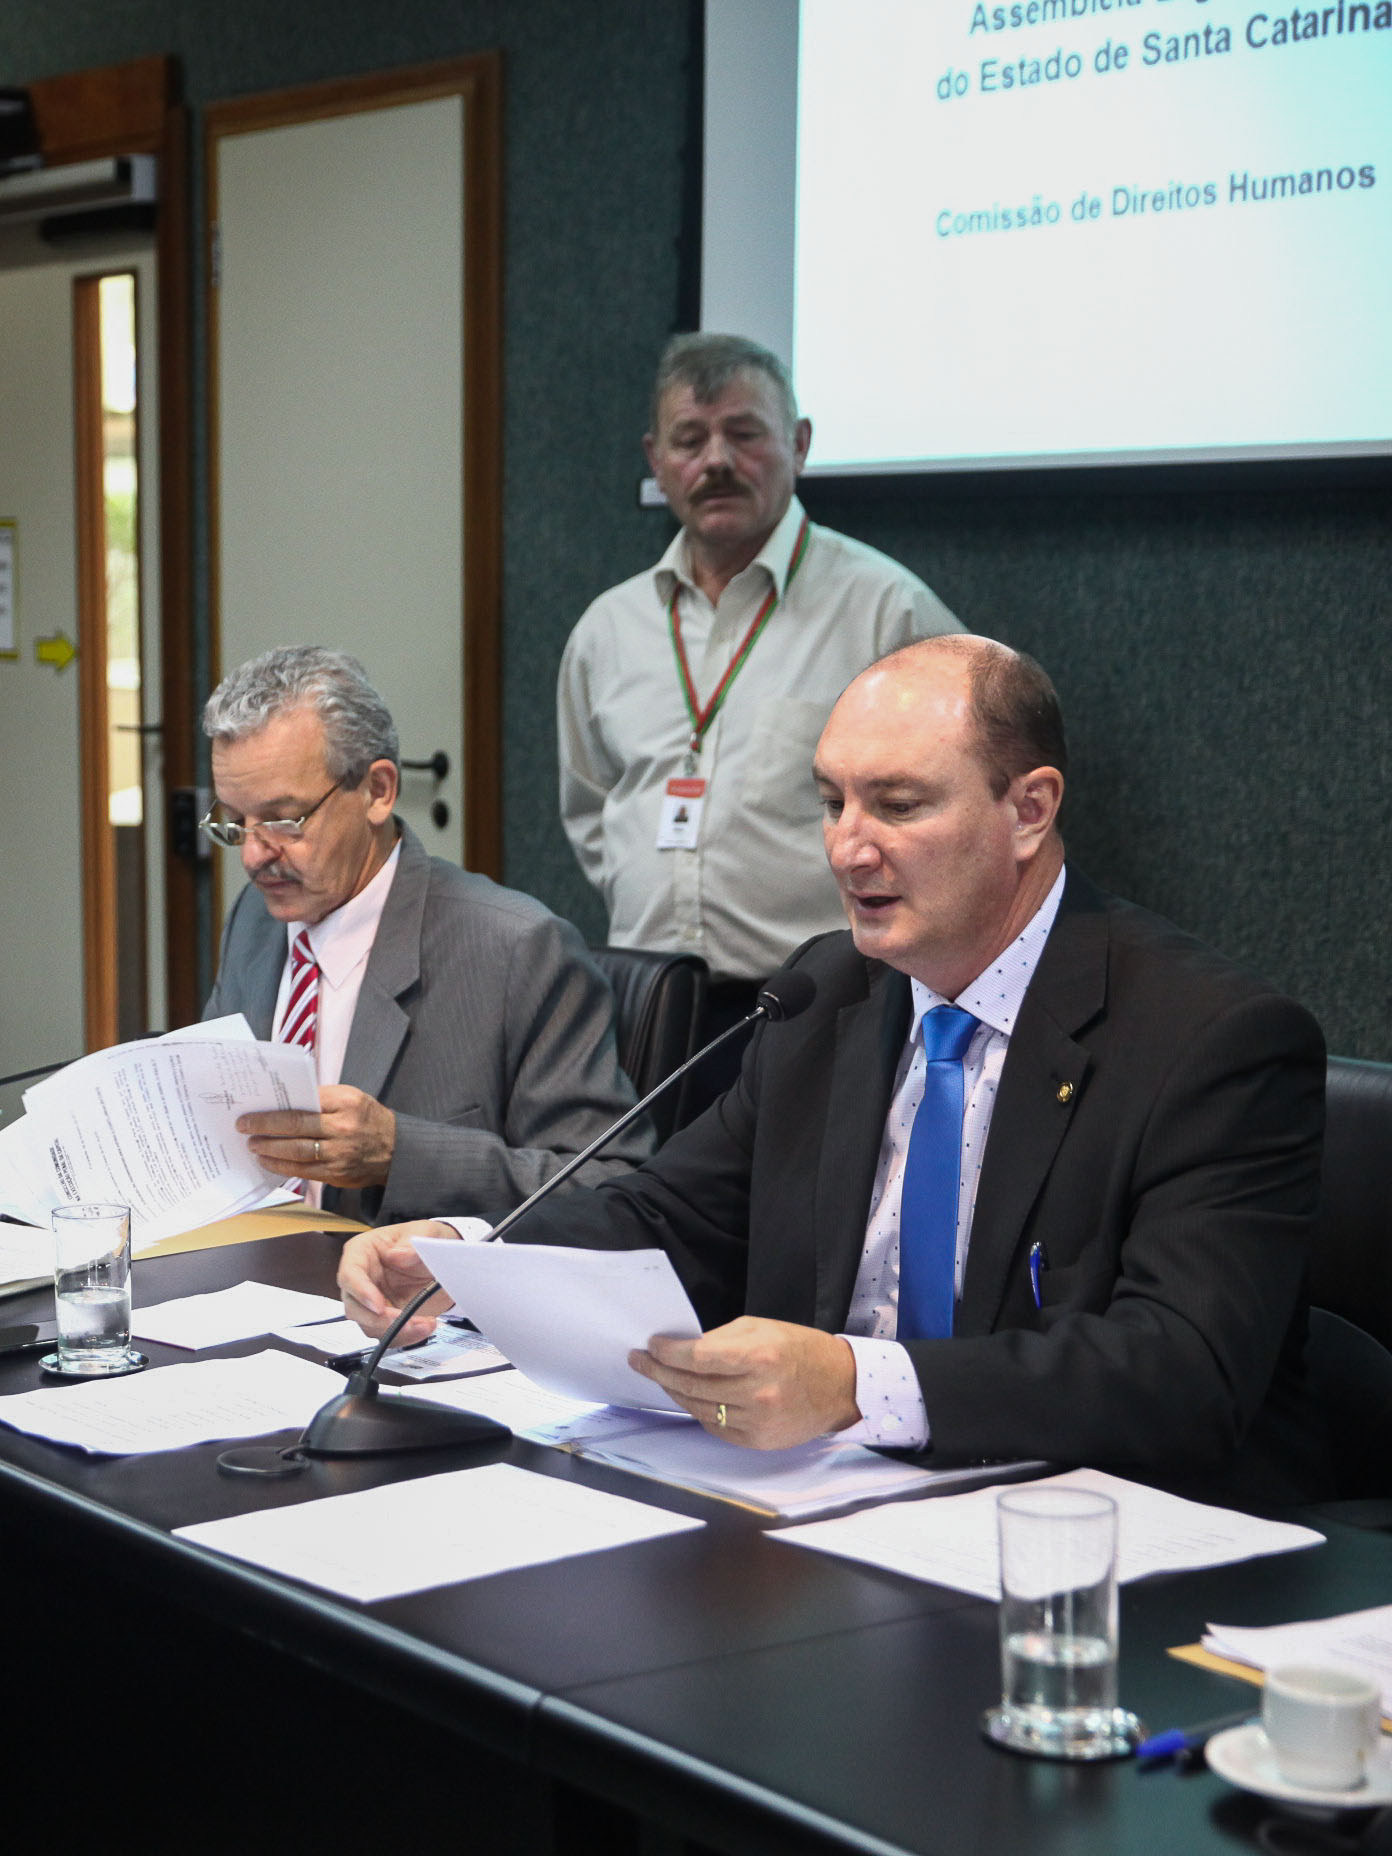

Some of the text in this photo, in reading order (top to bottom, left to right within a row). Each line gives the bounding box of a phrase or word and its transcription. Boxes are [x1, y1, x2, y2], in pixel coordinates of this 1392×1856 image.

[936, 0, 1392, 100] do Estado de Santa Catarina
[936, 164, 1376, 238] Comissão de Direitos Humanos
